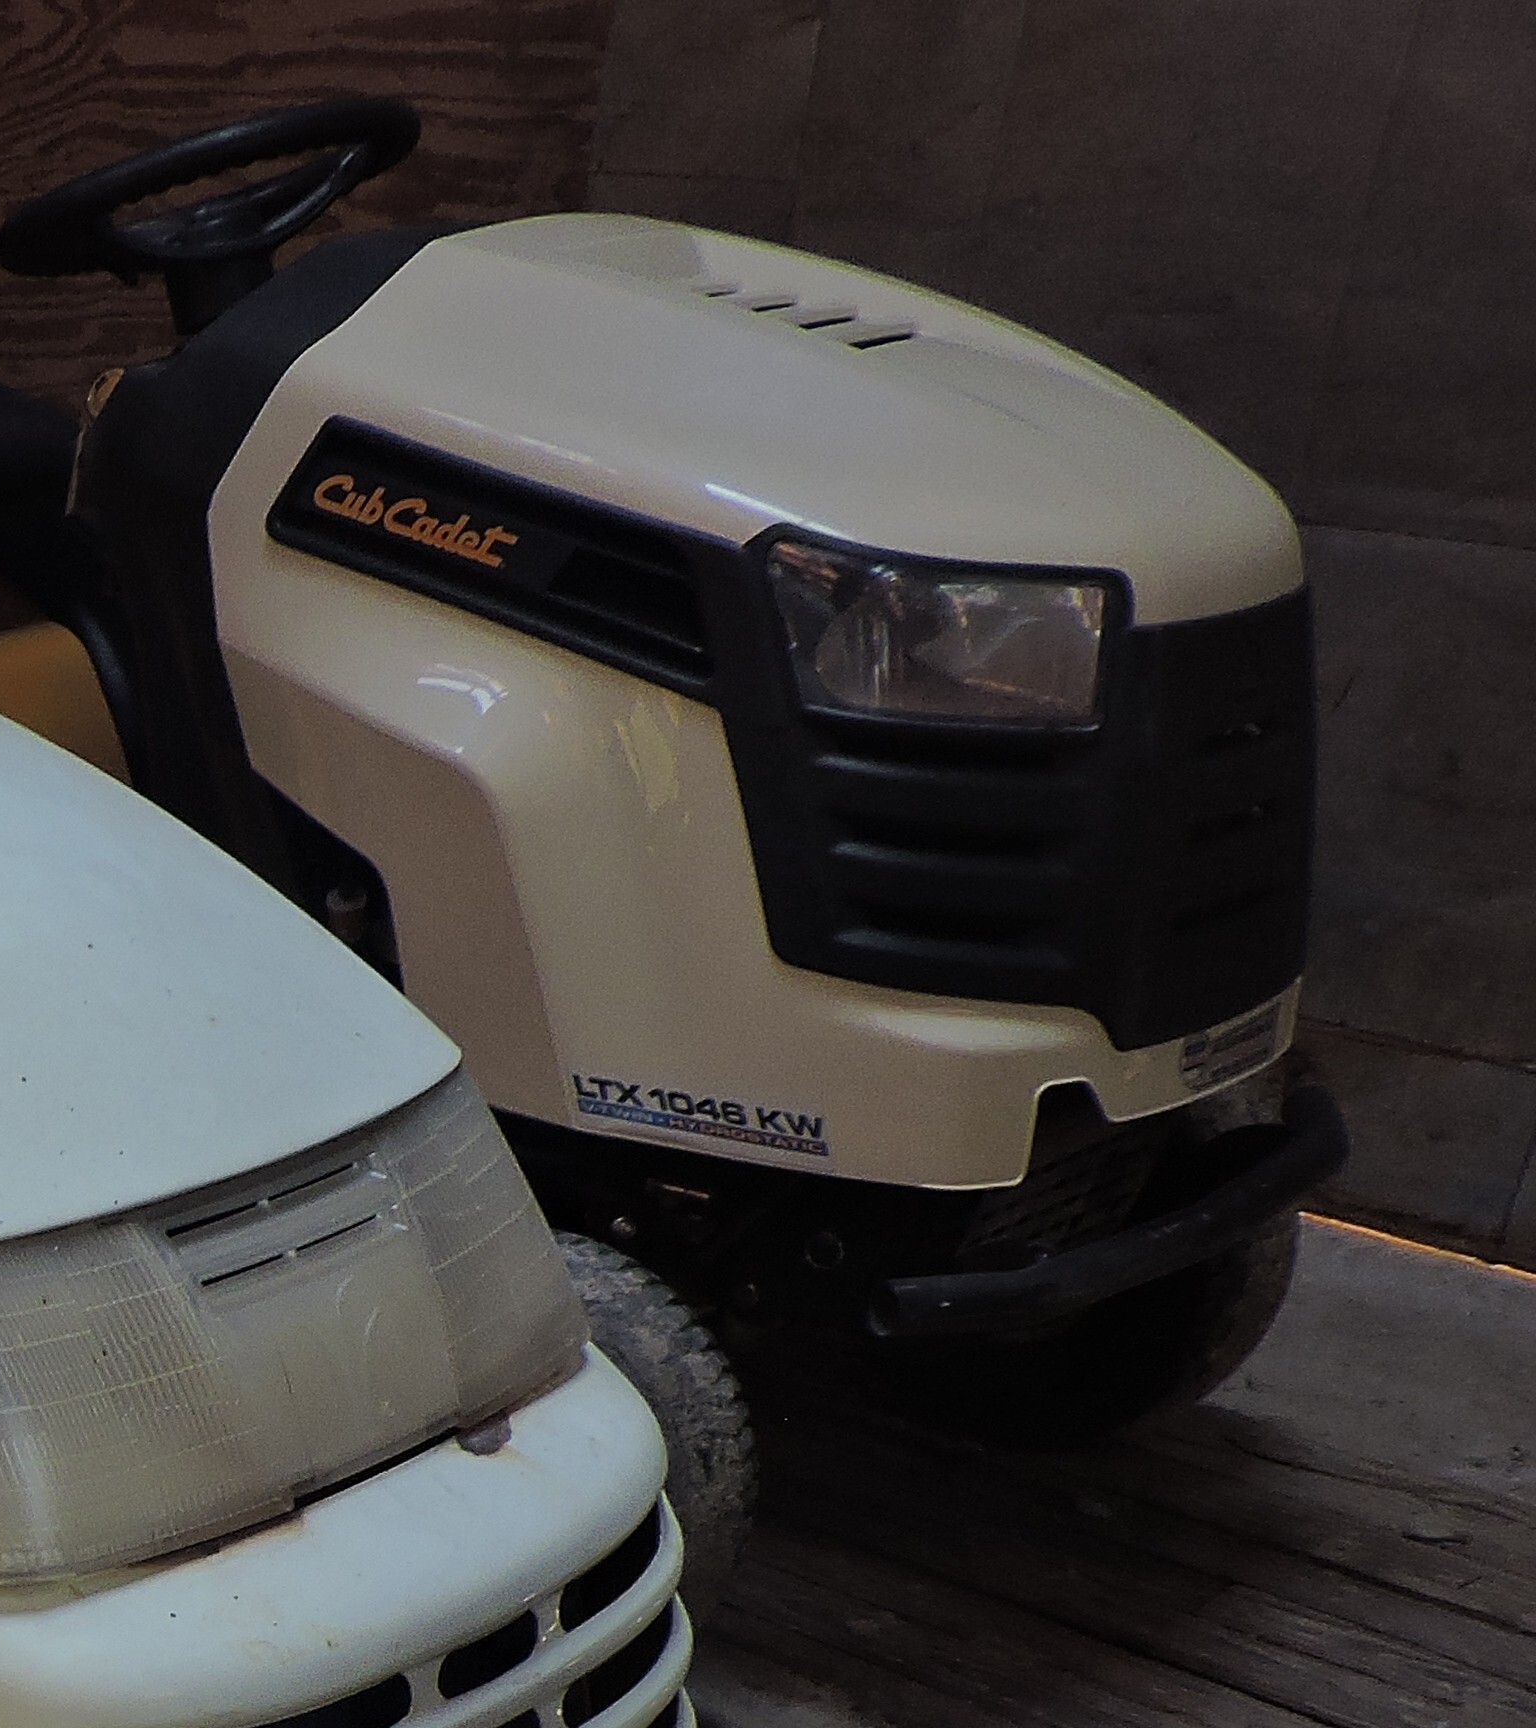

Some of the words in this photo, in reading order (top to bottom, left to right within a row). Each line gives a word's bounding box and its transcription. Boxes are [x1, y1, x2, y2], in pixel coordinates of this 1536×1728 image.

[313, 473, 386, 526] Cub
[383, 497, 520, 568] Cadet
[573, 1074, 645, 1107] LTX
[755, 1106, 824, 1139] KW
